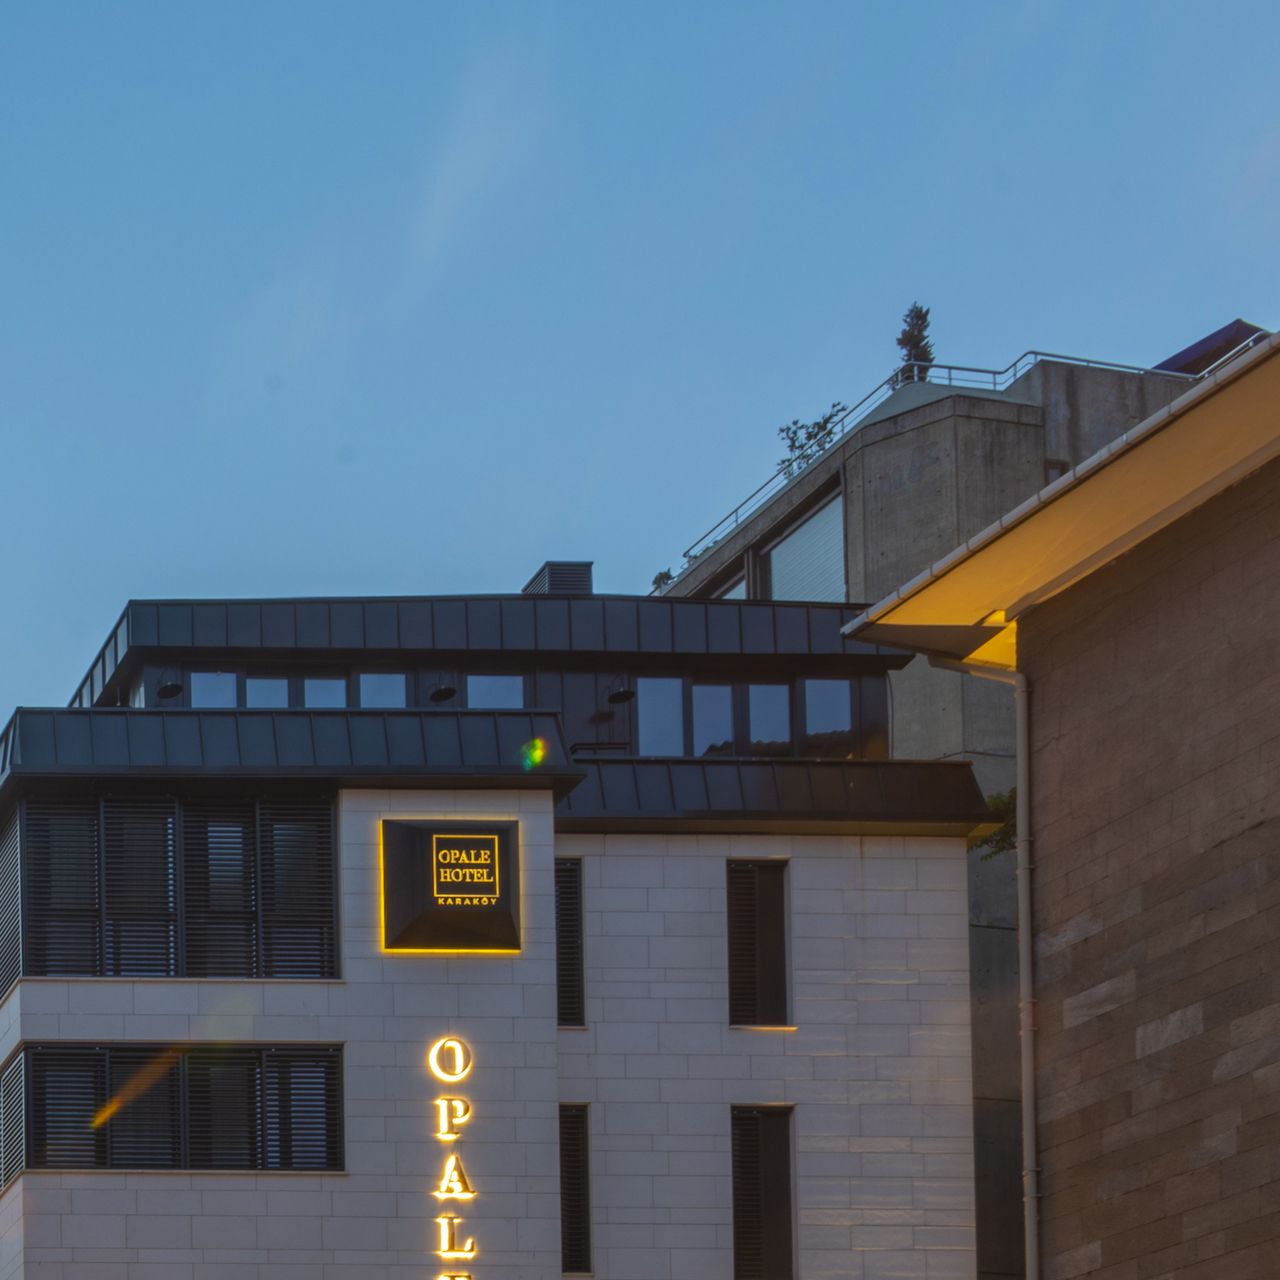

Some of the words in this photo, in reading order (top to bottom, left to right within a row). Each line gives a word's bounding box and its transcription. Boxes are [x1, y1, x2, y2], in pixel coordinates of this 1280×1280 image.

[438, 849, 491, 864] OPALE
[439, 868, 494, 882] HOTEL
[438, 897, 497, 906] KARAKÖY
